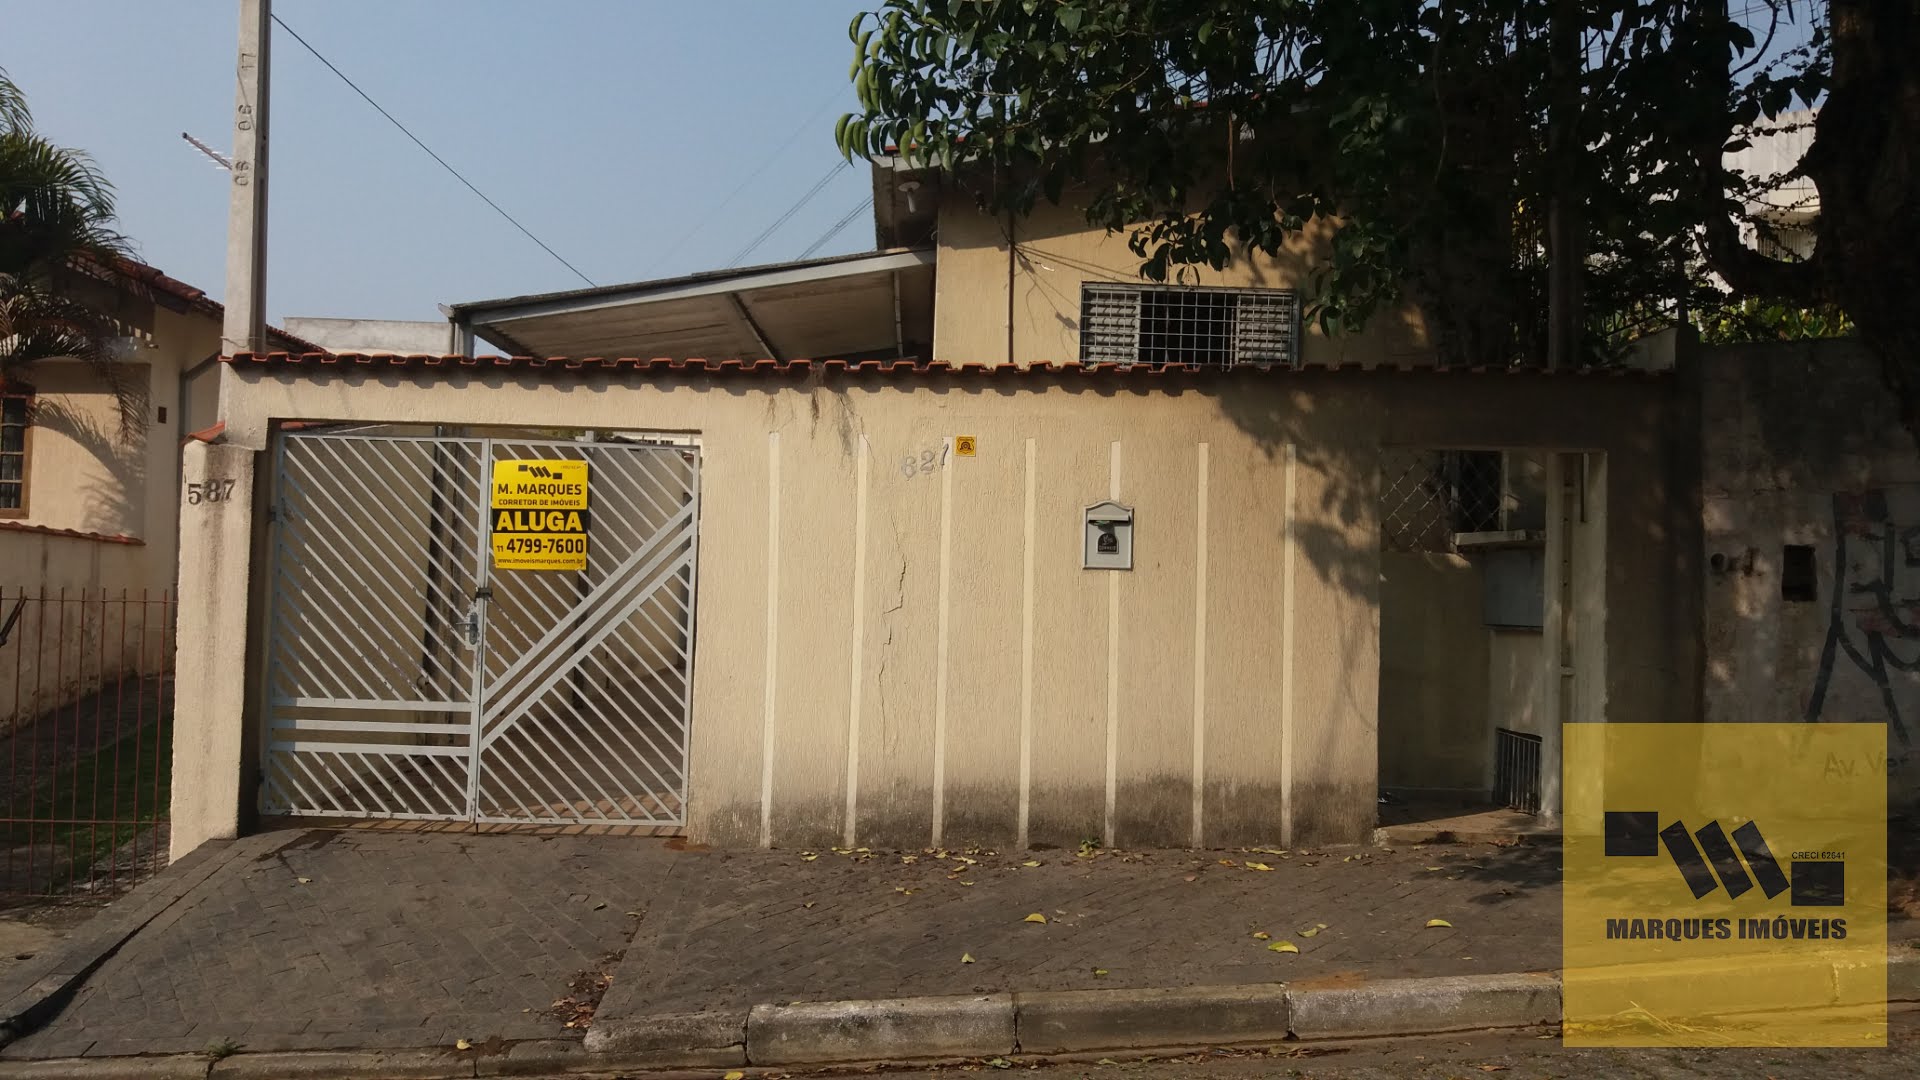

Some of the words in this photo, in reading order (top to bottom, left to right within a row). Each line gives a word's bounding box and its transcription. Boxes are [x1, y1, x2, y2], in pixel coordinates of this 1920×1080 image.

[187, 479, 236, 505] 587
[497, 483, 513, 495] M.
[516, 483, 582, 497] MARQUES
[550, 497, 581, 506] IMÓVEIS
[496, 511, 583, 532] ALUGA
[506, 538, 584, 553] 4799-7600
